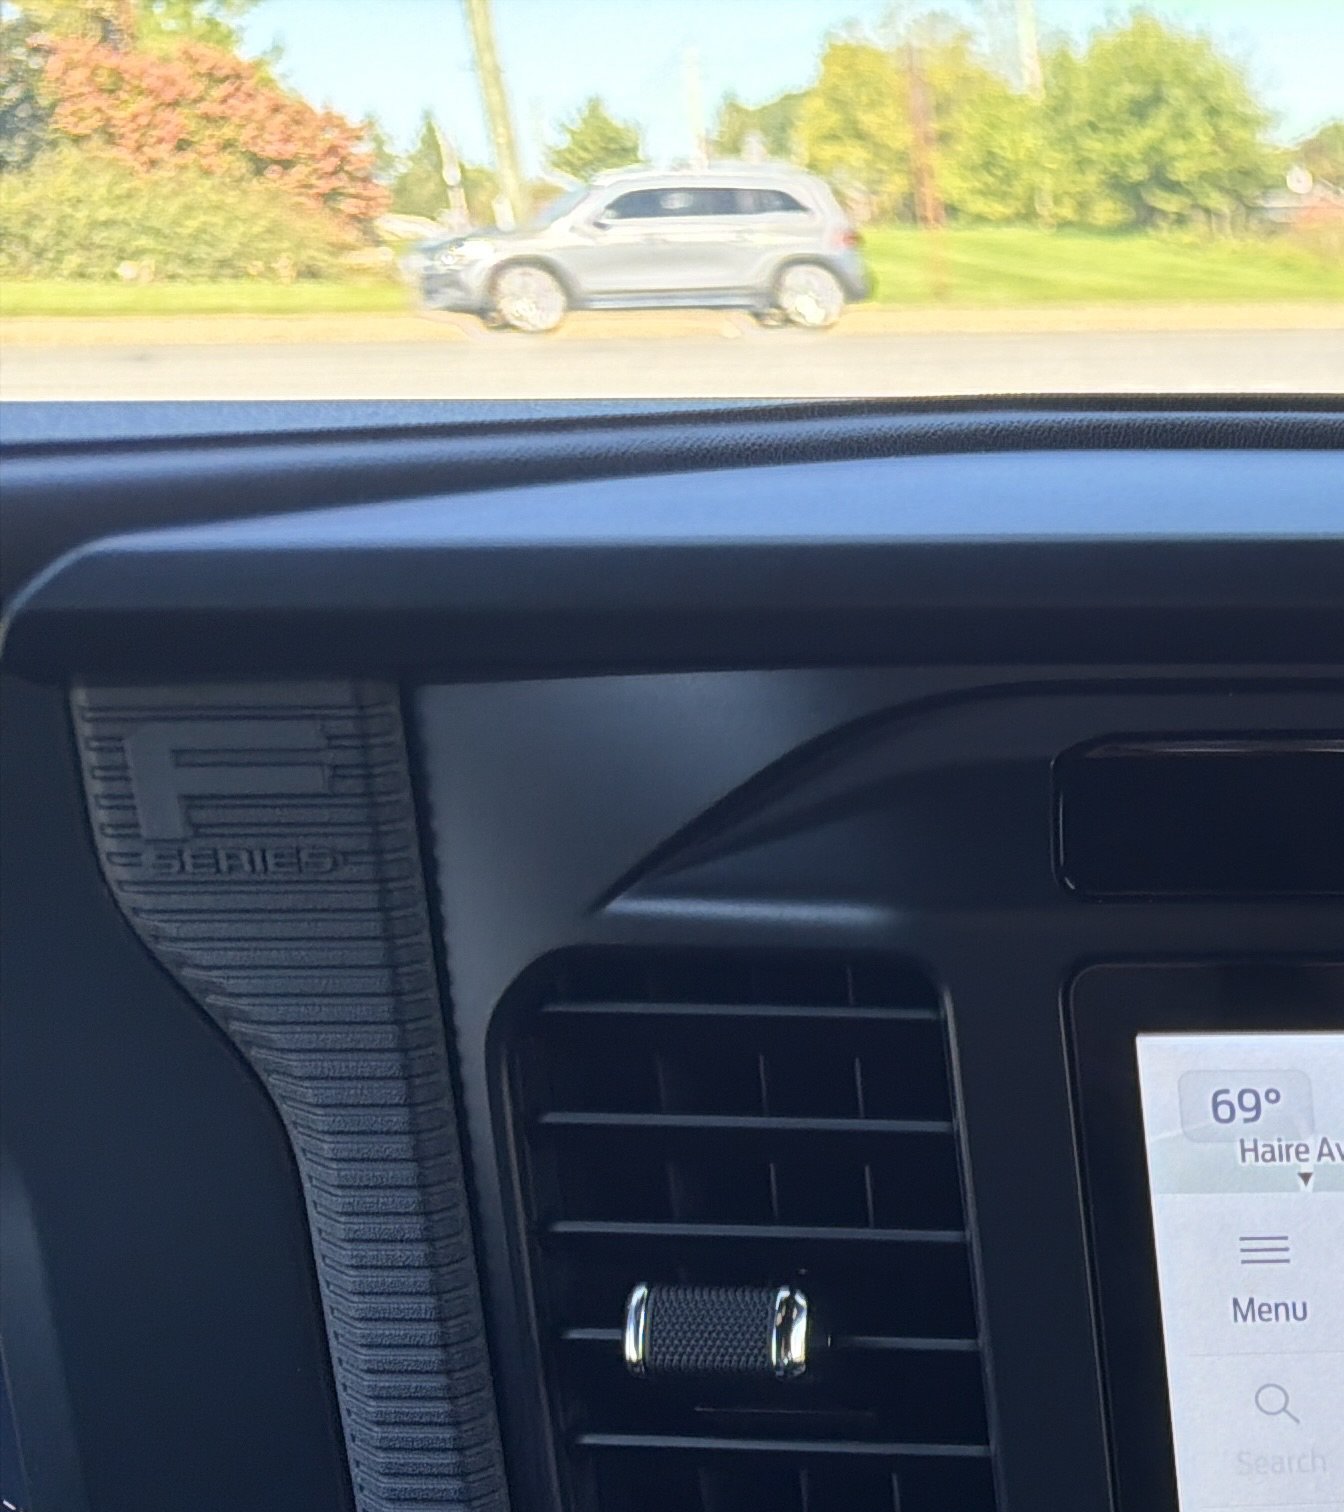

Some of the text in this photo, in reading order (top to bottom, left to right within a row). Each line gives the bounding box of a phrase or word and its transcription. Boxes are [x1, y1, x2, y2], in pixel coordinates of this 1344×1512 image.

[1211, 1087, 1282, 1125] 69°
[1239, 1137, 1310, 1163] Haire
[1232, 1297, 1308, 1324] Menu
[1237, 1449, 1327, 1475] Search
